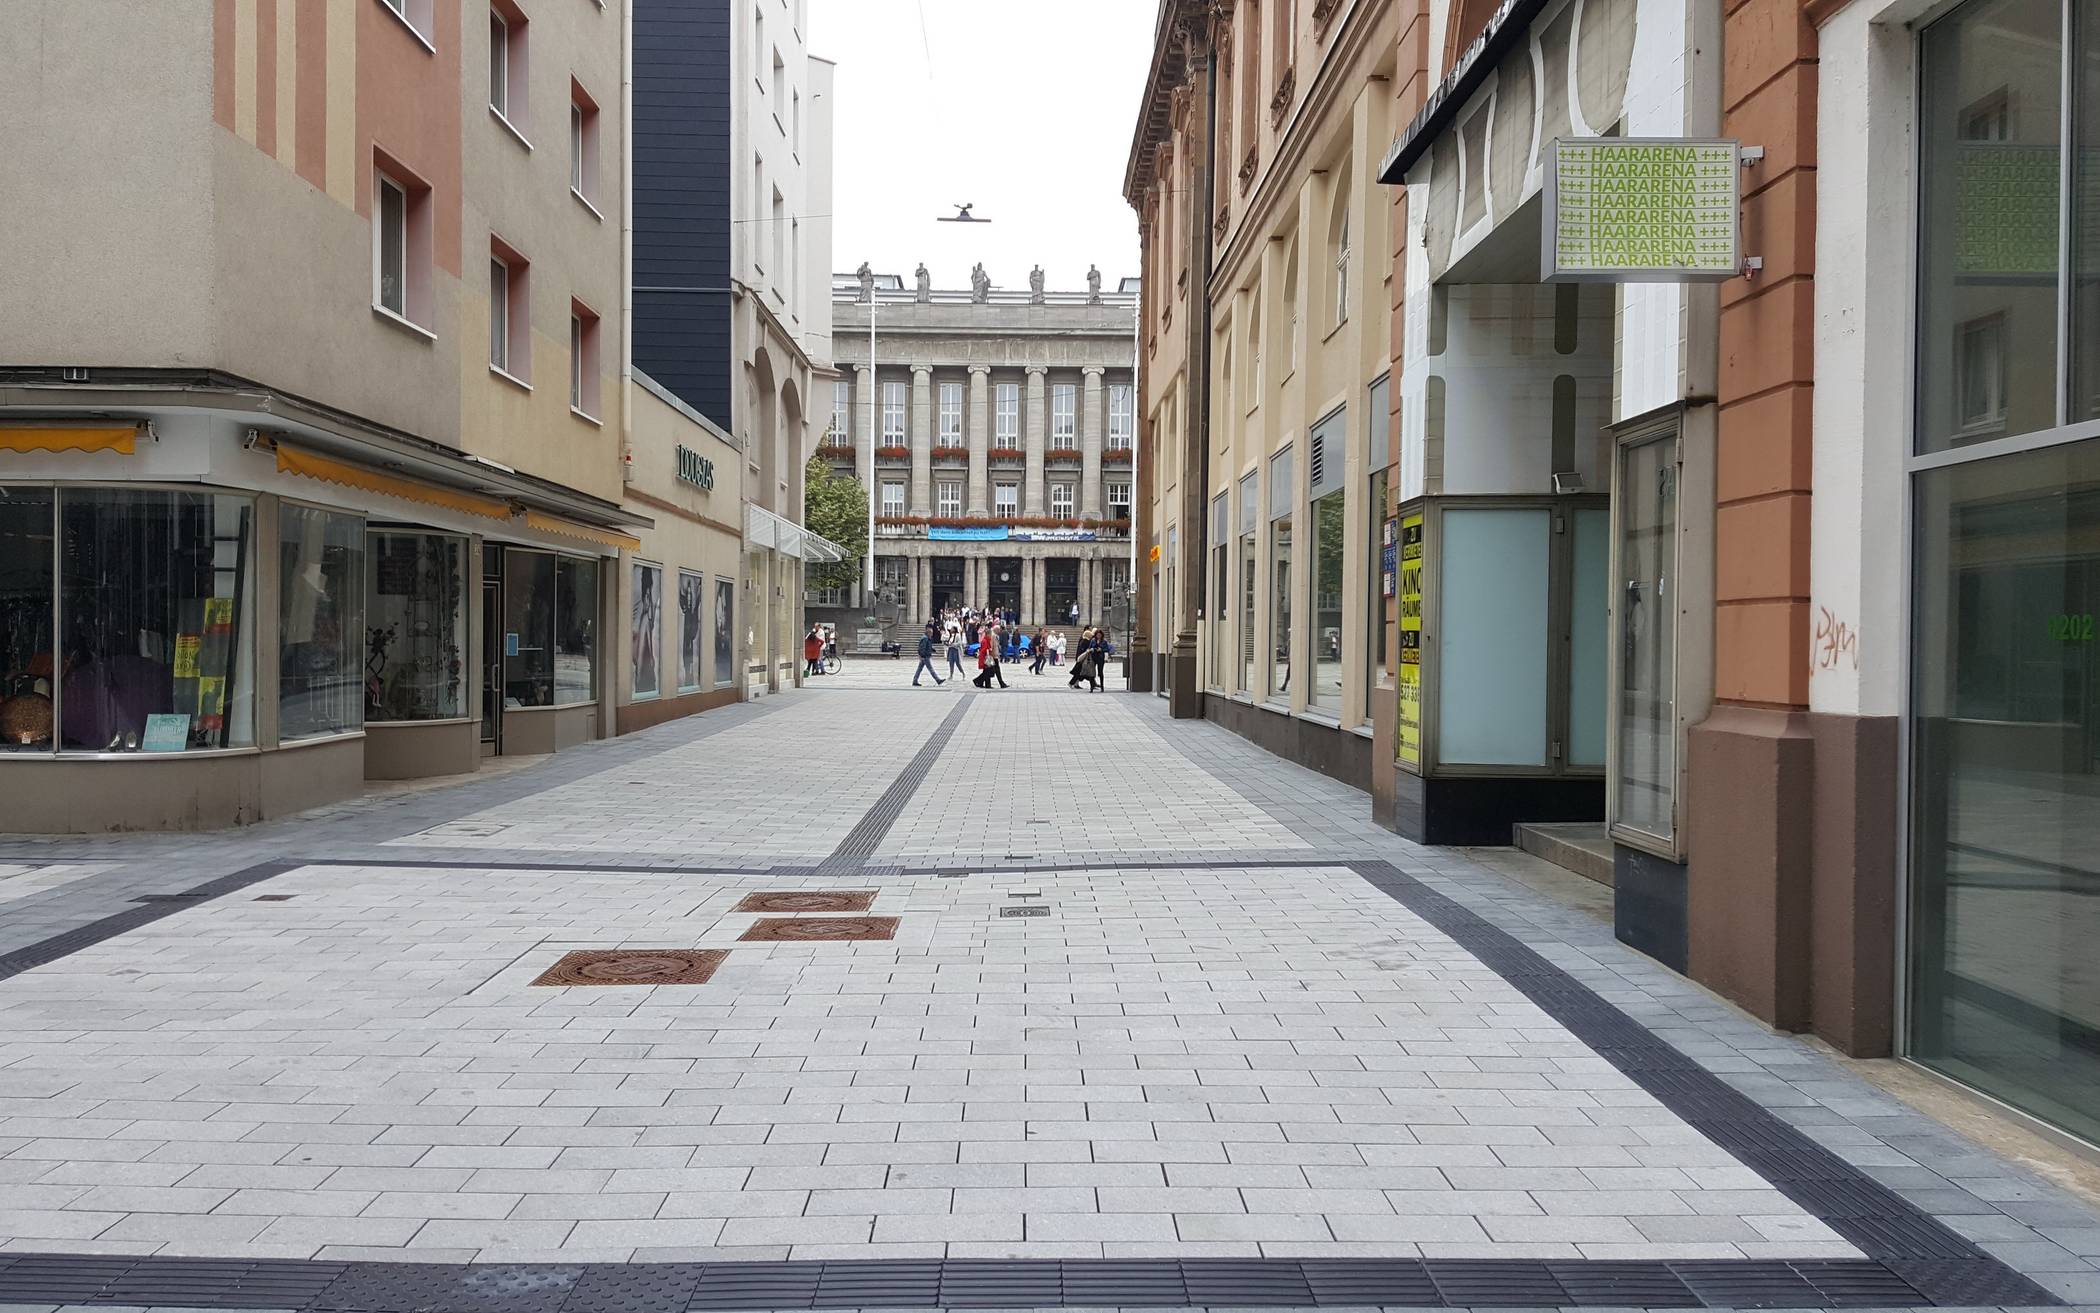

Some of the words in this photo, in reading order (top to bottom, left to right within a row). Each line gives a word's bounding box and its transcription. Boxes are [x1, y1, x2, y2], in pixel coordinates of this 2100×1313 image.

[1592, 147, 1697, 161] HAARARENA
[1591, 164, 1696, 176] HAARARENA
[1590, 179, 1696, 192] HAARARENA
[1590, 195, 1696, 207] HAARARENA
[1590, 210, 1696, 223] HAARARENA
[1590, 225, 1695, 238] HAARARENA
[1590, 240, 1696, 253] HAARARENA
[1592, 254, 1696, 266] HAARARENA
